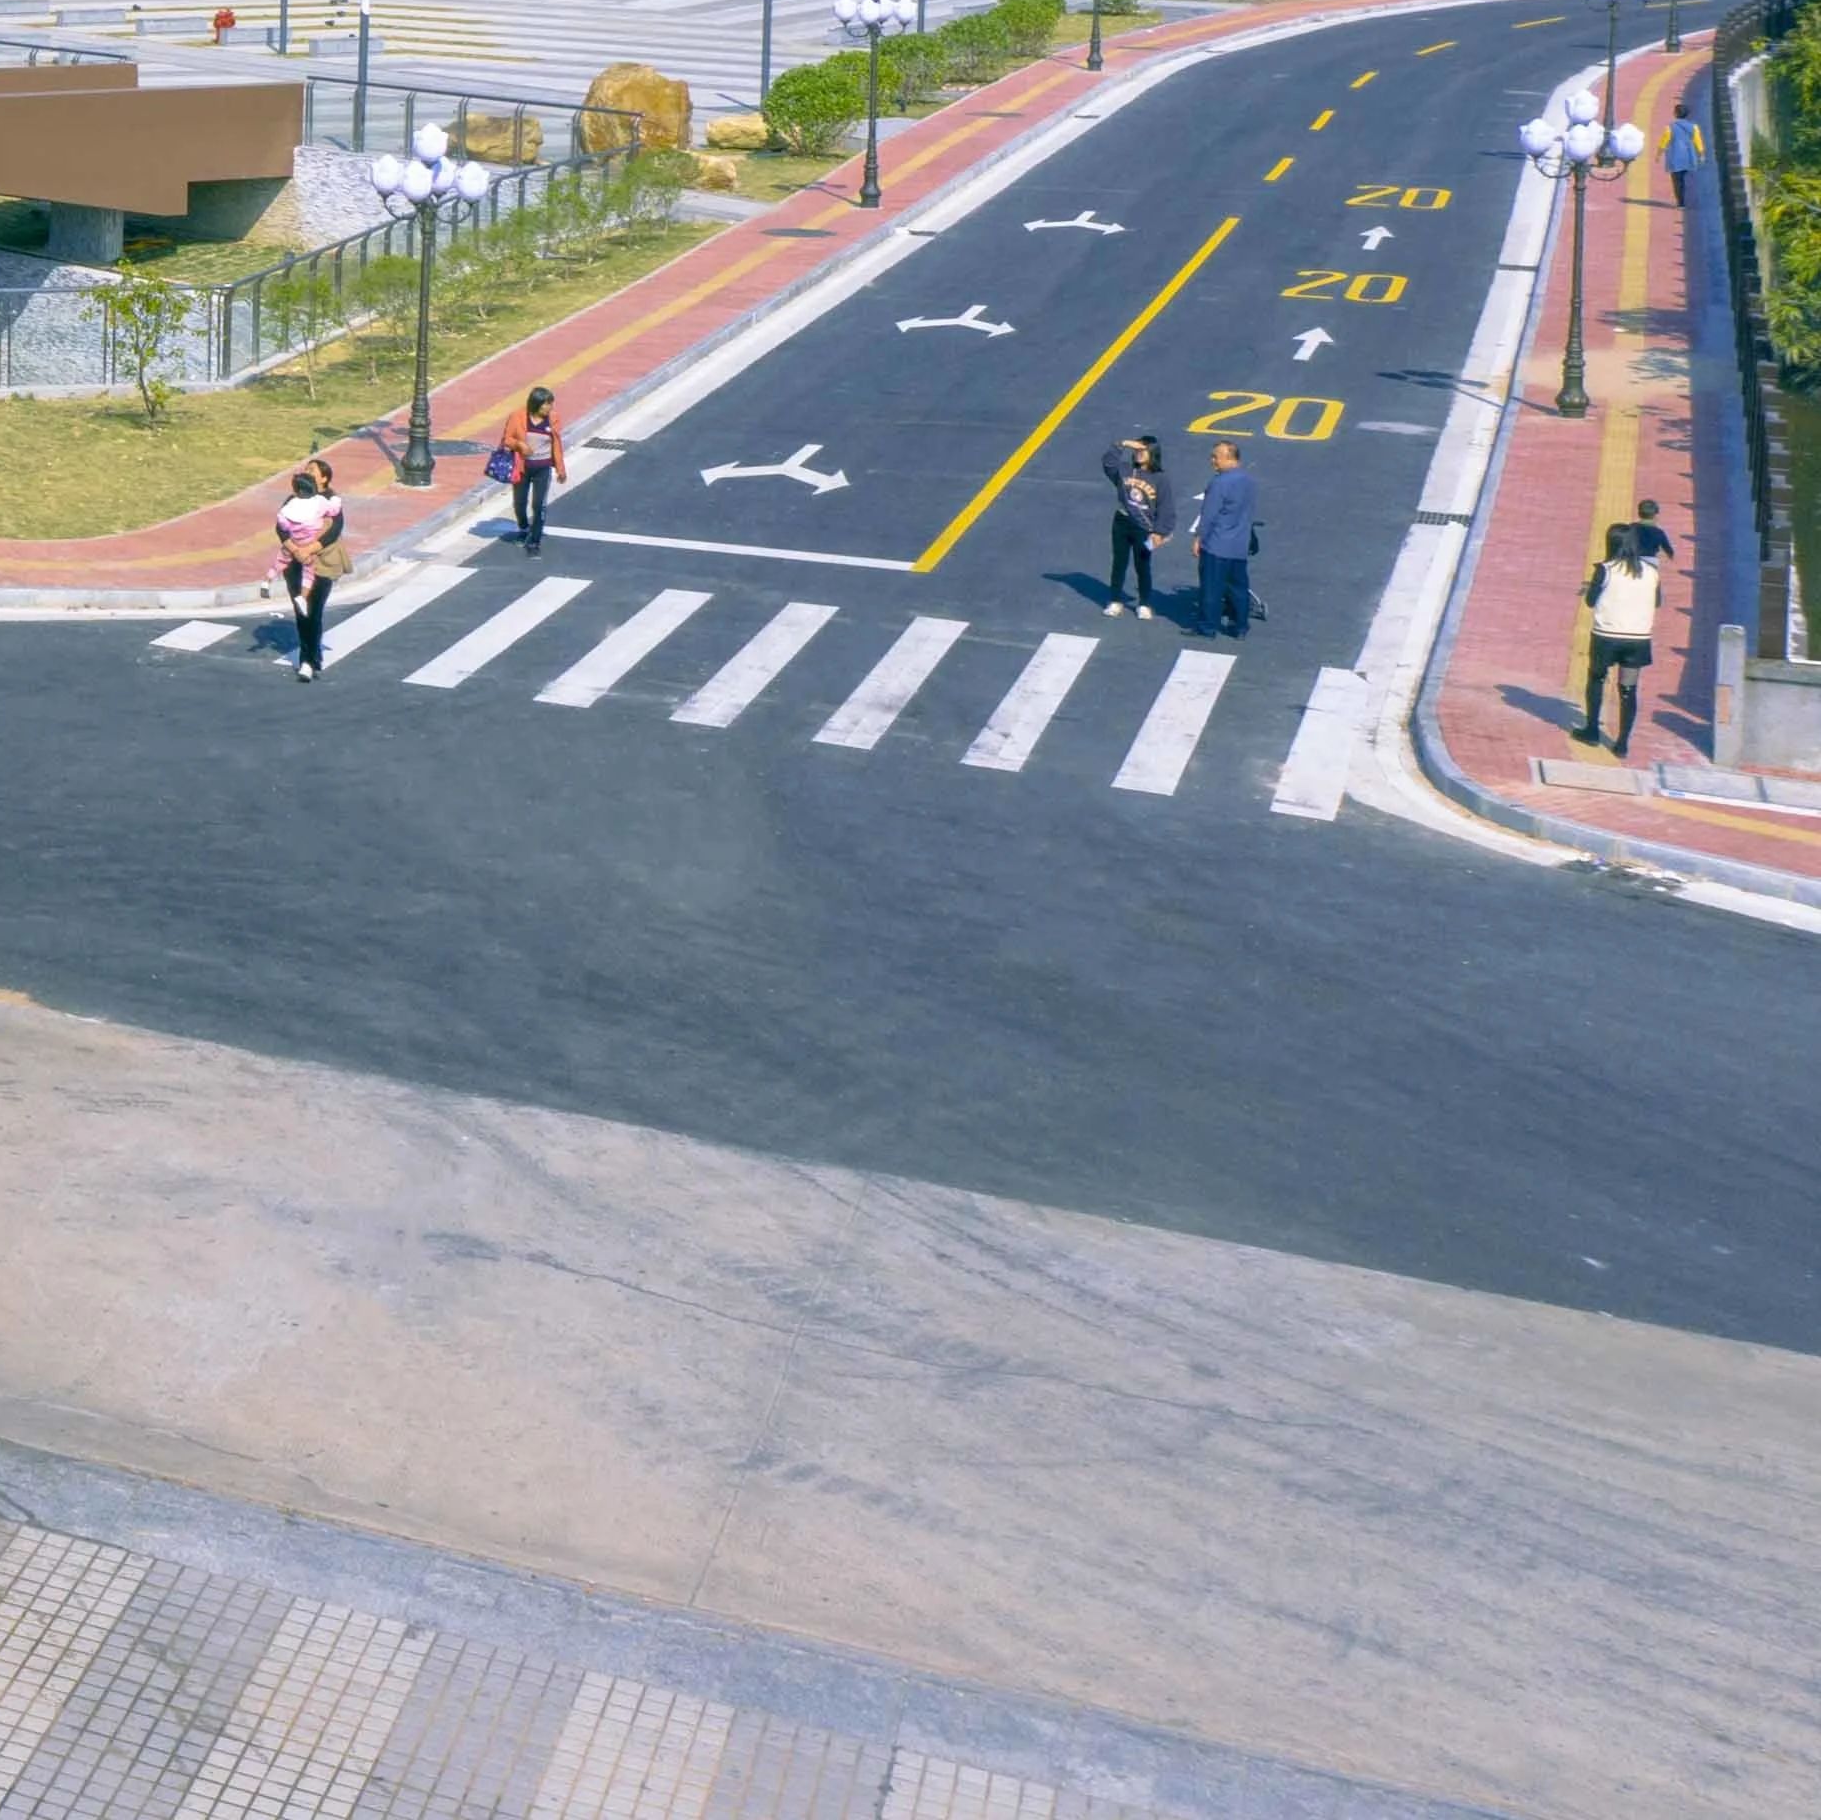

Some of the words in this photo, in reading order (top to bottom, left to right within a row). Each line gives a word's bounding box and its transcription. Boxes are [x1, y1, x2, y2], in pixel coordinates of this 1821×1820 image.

[1345, 185, 1453, 210] 20
[1281, 270, 1408, 303] 20
[1186, 391, 1345, 441] 20
